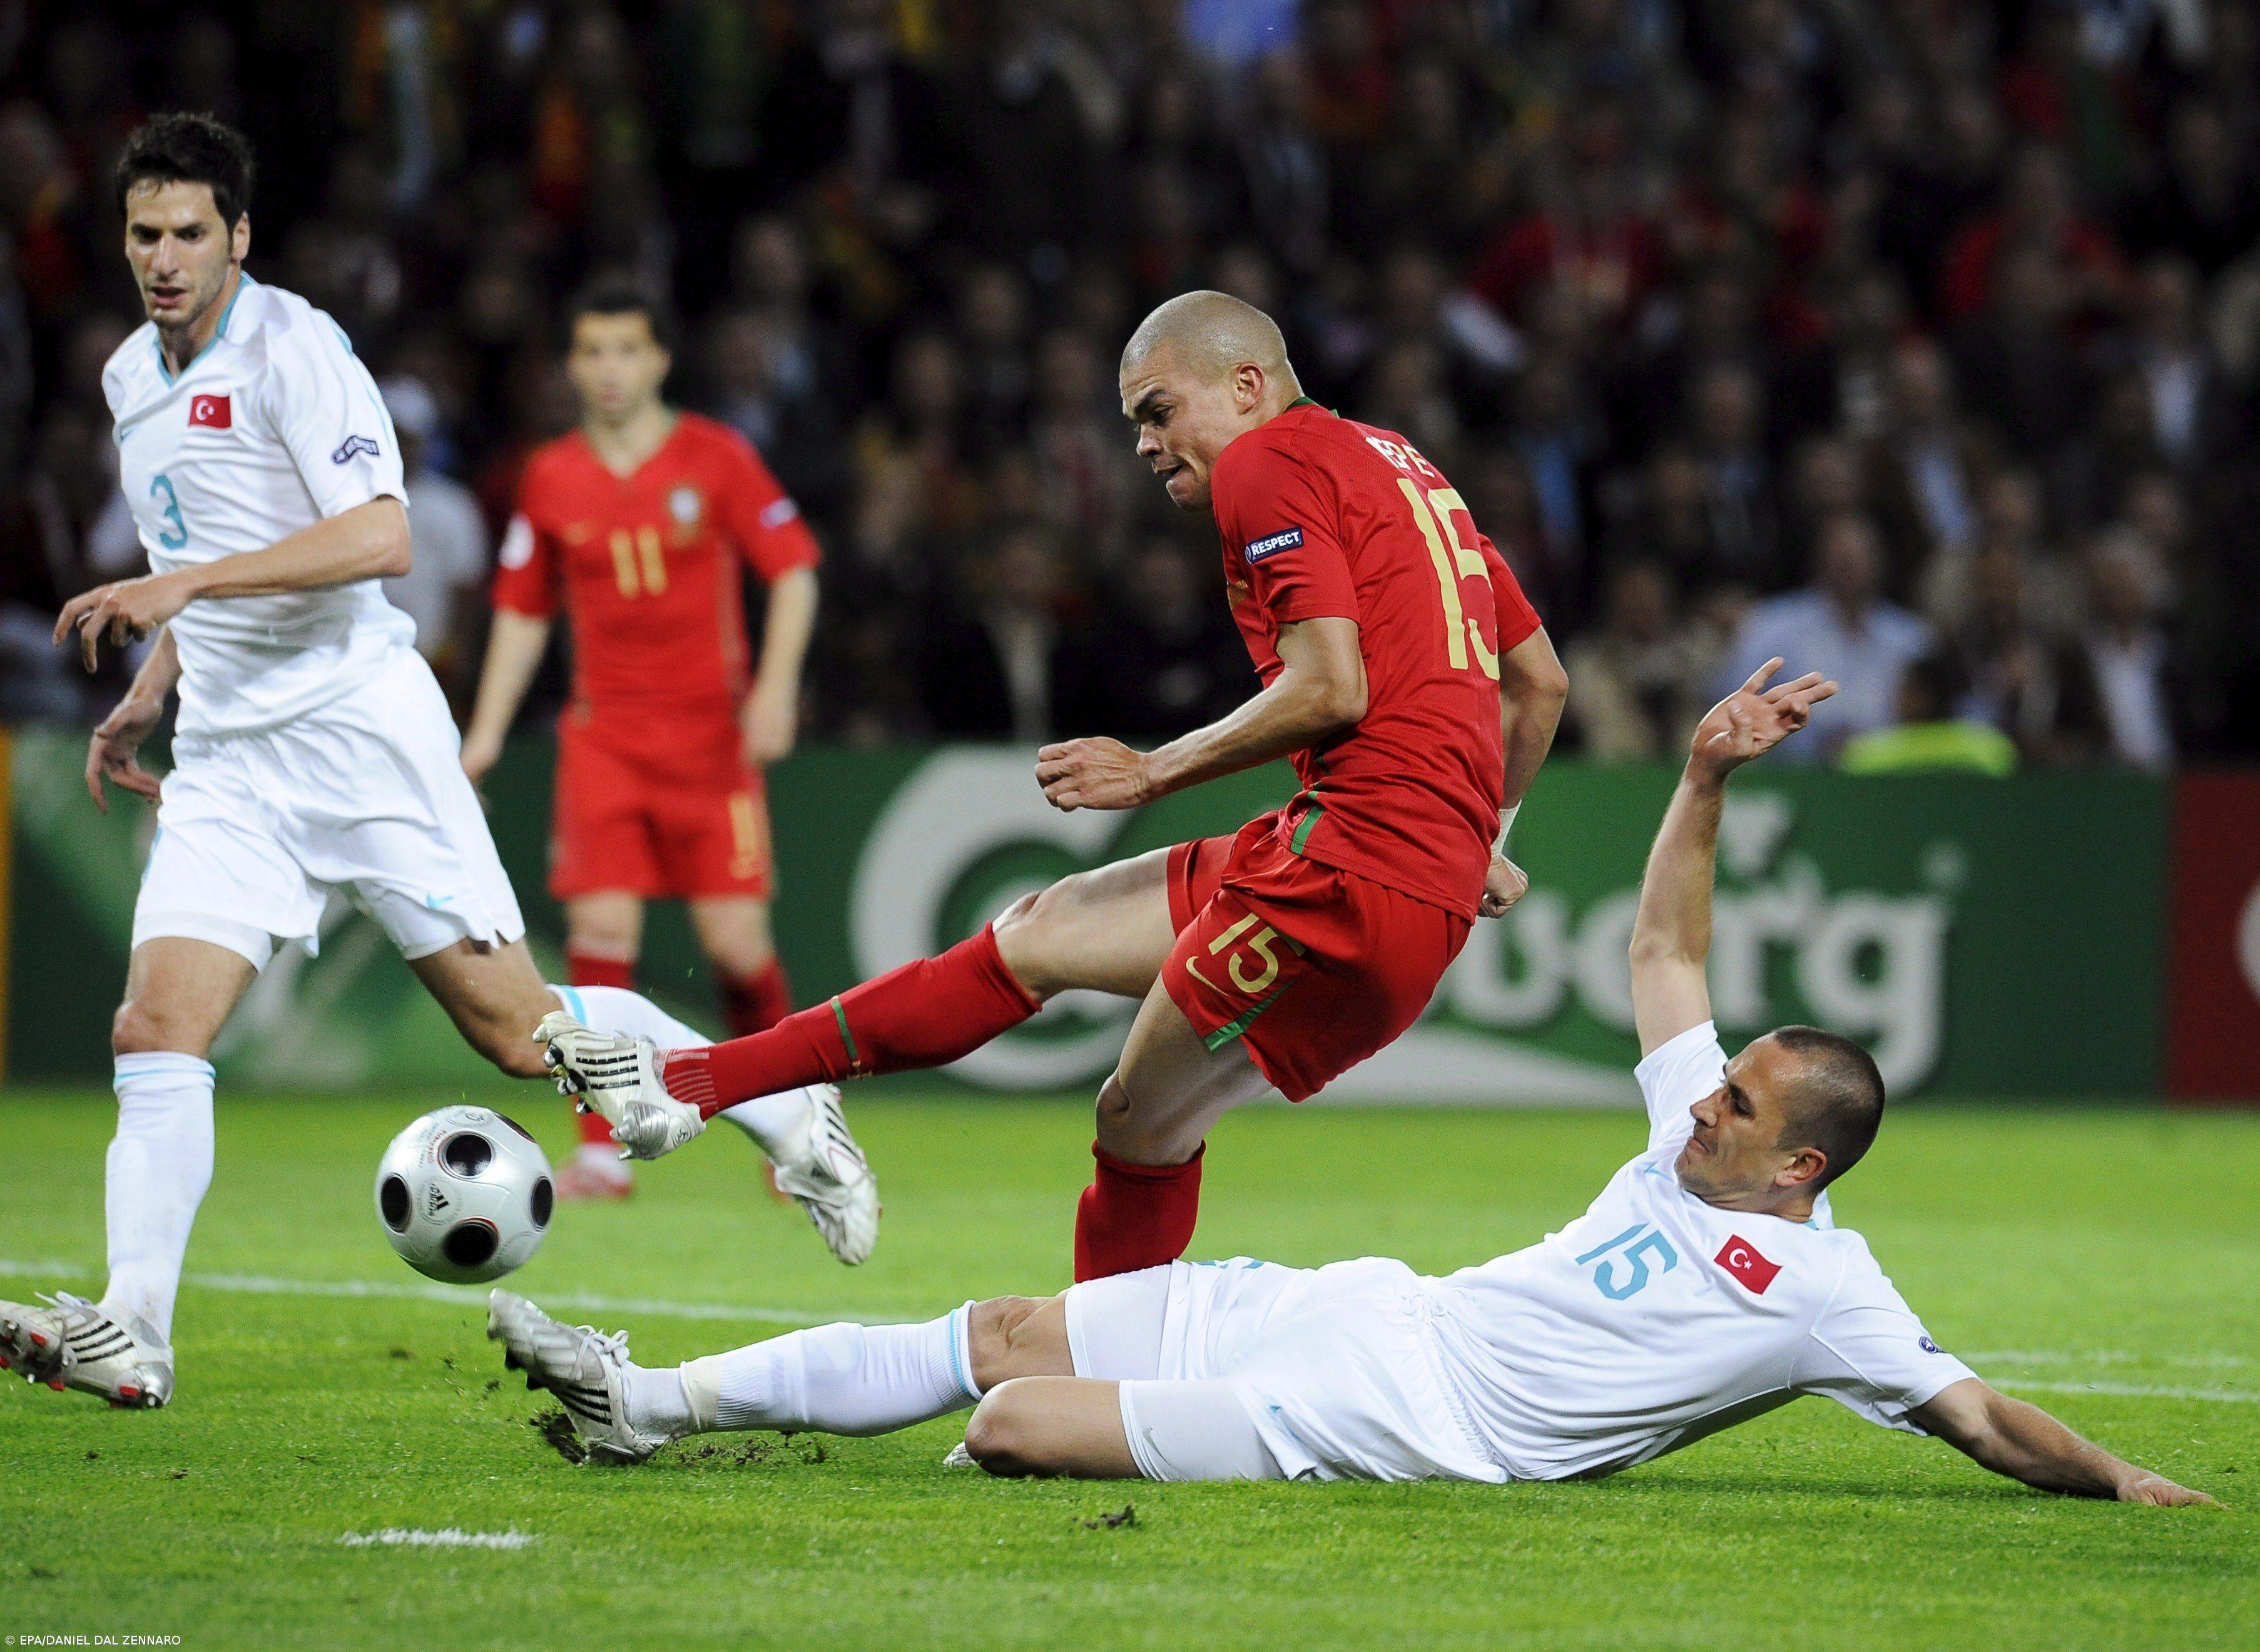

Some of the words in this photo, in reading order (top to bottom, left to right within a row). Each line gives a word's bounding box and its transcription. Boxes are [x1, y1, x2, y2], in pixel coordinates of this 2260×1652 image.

[151, 474, 188, 550] 3
[1251, 531, 1300, 556] RESPECT
[609, 527, 668, 596] 11
[1397, 478, 1500, 681] 15
[1208, 912, 1278, 993] 15
[1575, 1223, 1678, 1300] 15
